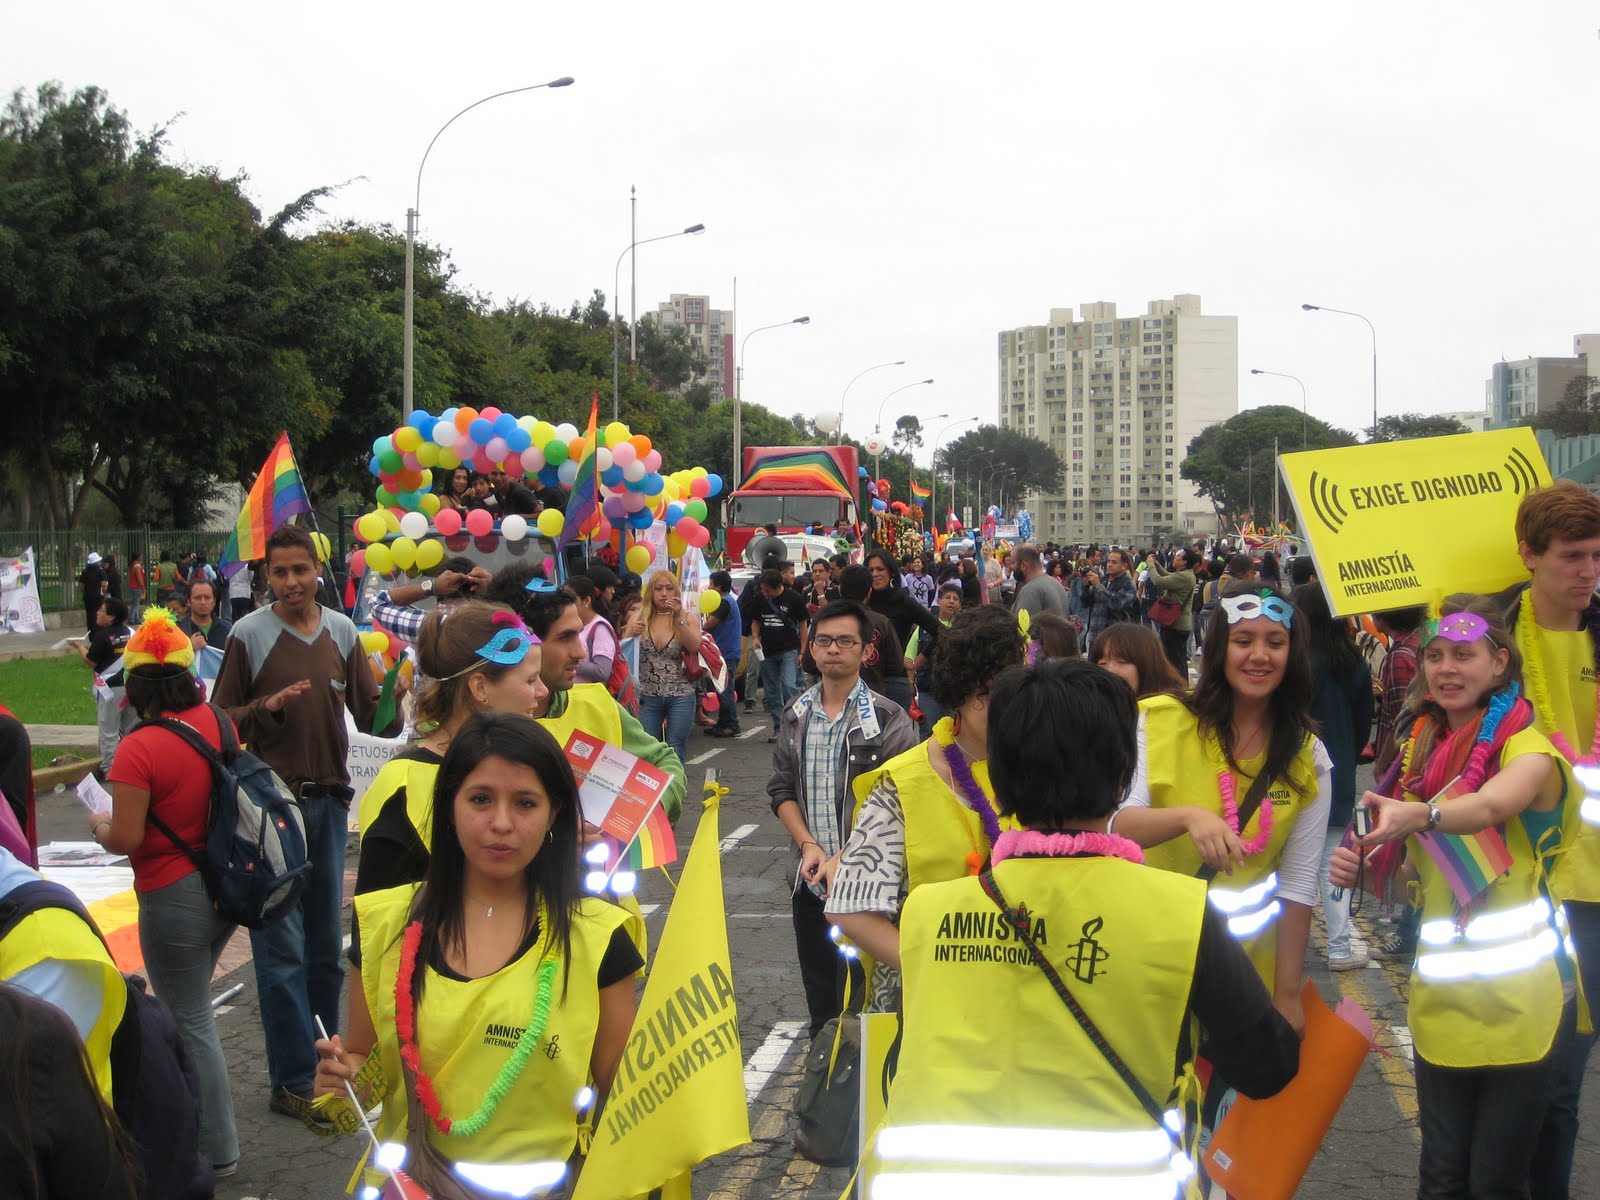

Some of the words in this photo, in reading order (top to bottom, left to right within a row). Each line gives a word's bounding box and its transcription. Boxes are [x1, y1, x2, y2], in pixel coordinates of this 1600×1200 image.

[1349, 483, 1410, 510] EXIGE
[1410, 471, 1503, 502] DIGNIDAD
[1338, 550, 1415, 582] AMNISTÍA
[1344, 575, 1422, 597] INTERNACIONAL
[934, 944, 1042, 967] INTERNACIONA
